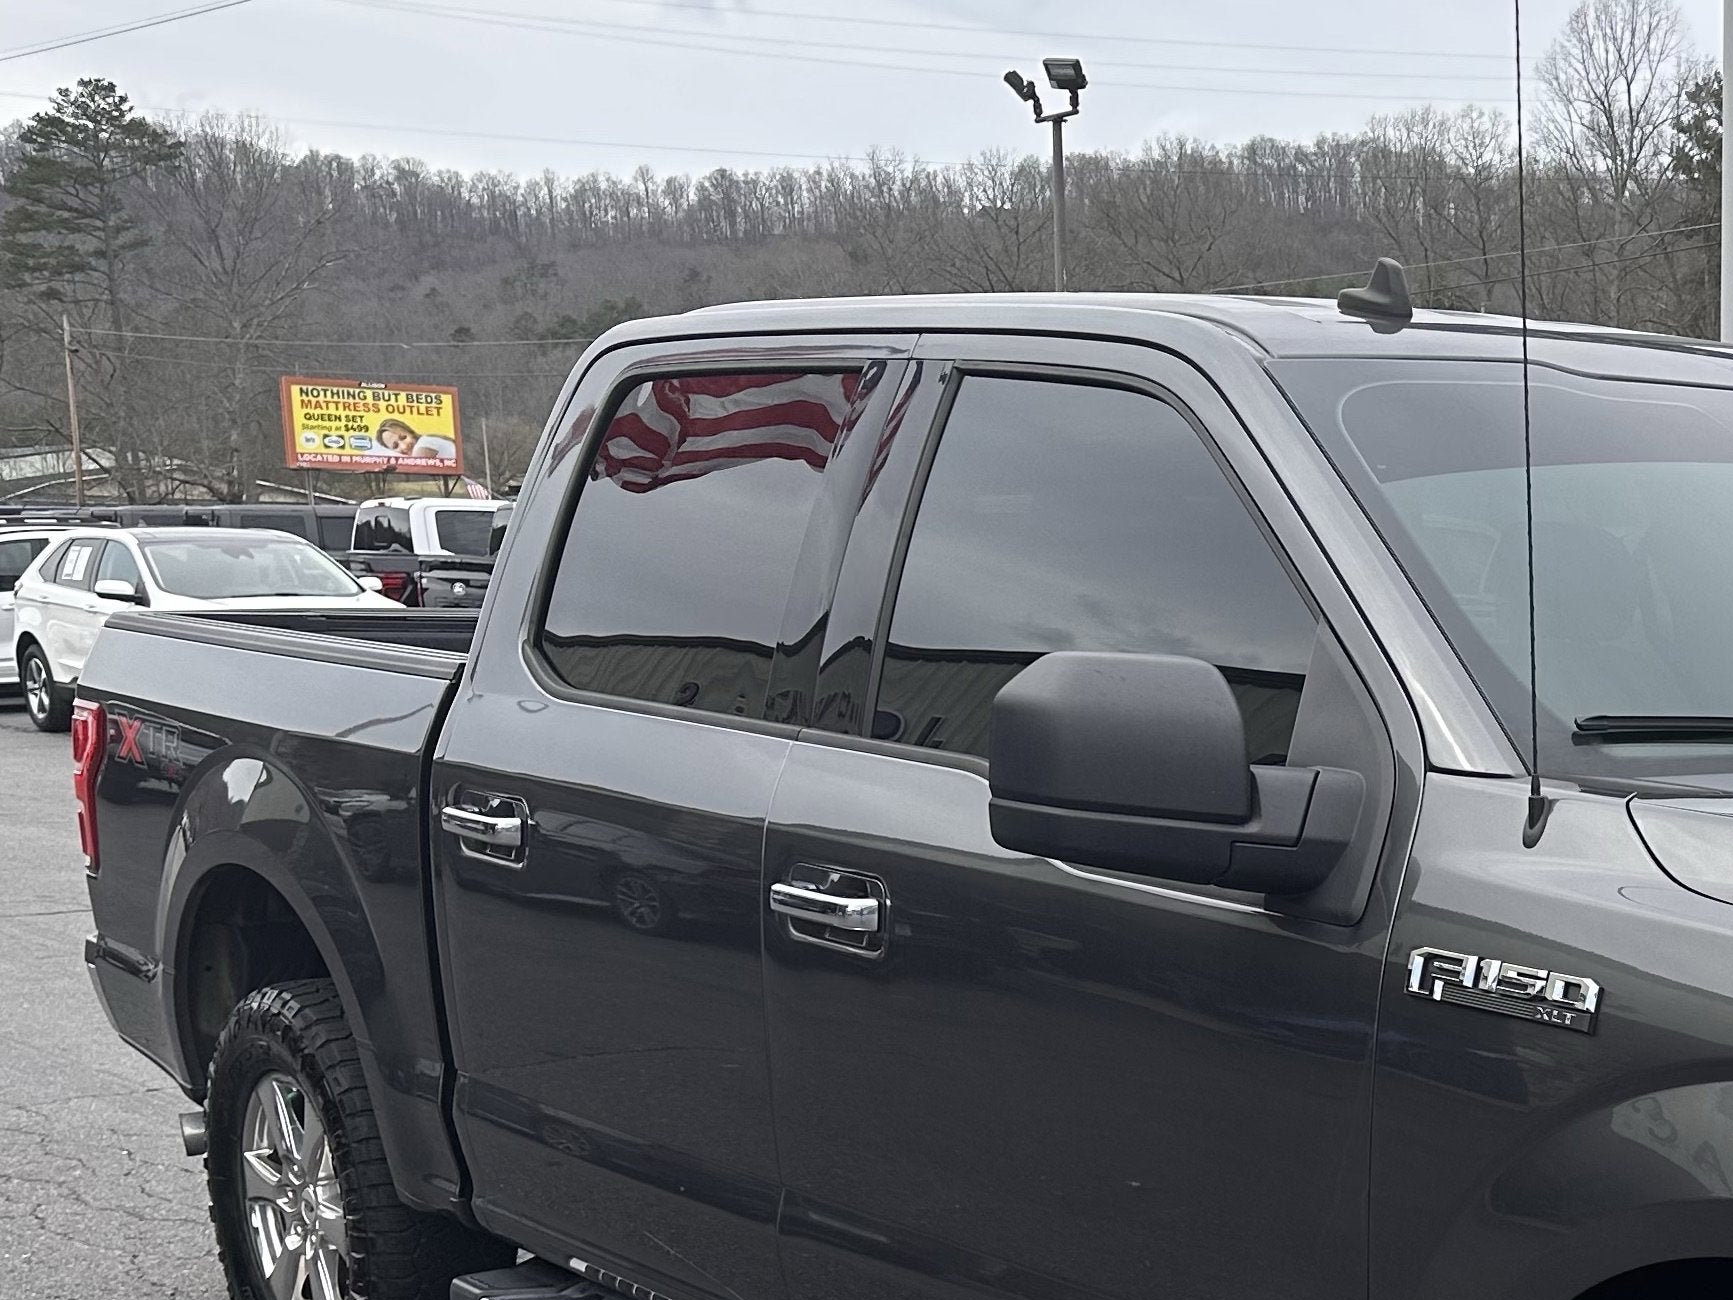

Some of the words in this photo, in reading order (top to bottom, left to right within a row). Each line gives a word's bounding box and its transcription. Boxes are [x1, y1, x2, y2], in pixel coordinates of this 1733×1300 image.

[299, 387, 367, 401] NOTHING
[372, 391, 401, 403] BUT
[406, 393, 443, 405] BEDS
[300, 399, 380, 413] MATTRESS
[385, 404, 443, 416] OUTLET
[303, 412, 342, 422] QUEEN
[344, 414, 365, 423] SET
[301, 423, 333, 432] Starting
[343, 423, 370, 433] $499
[297, 453, 340, 463] LOCATED
[341, 455, 351, 463] IN
[352, 456, 389, 465] MURPHY
[389, 456, 397, 464] &
[1536, 1006, 1577, 1026] XLT
